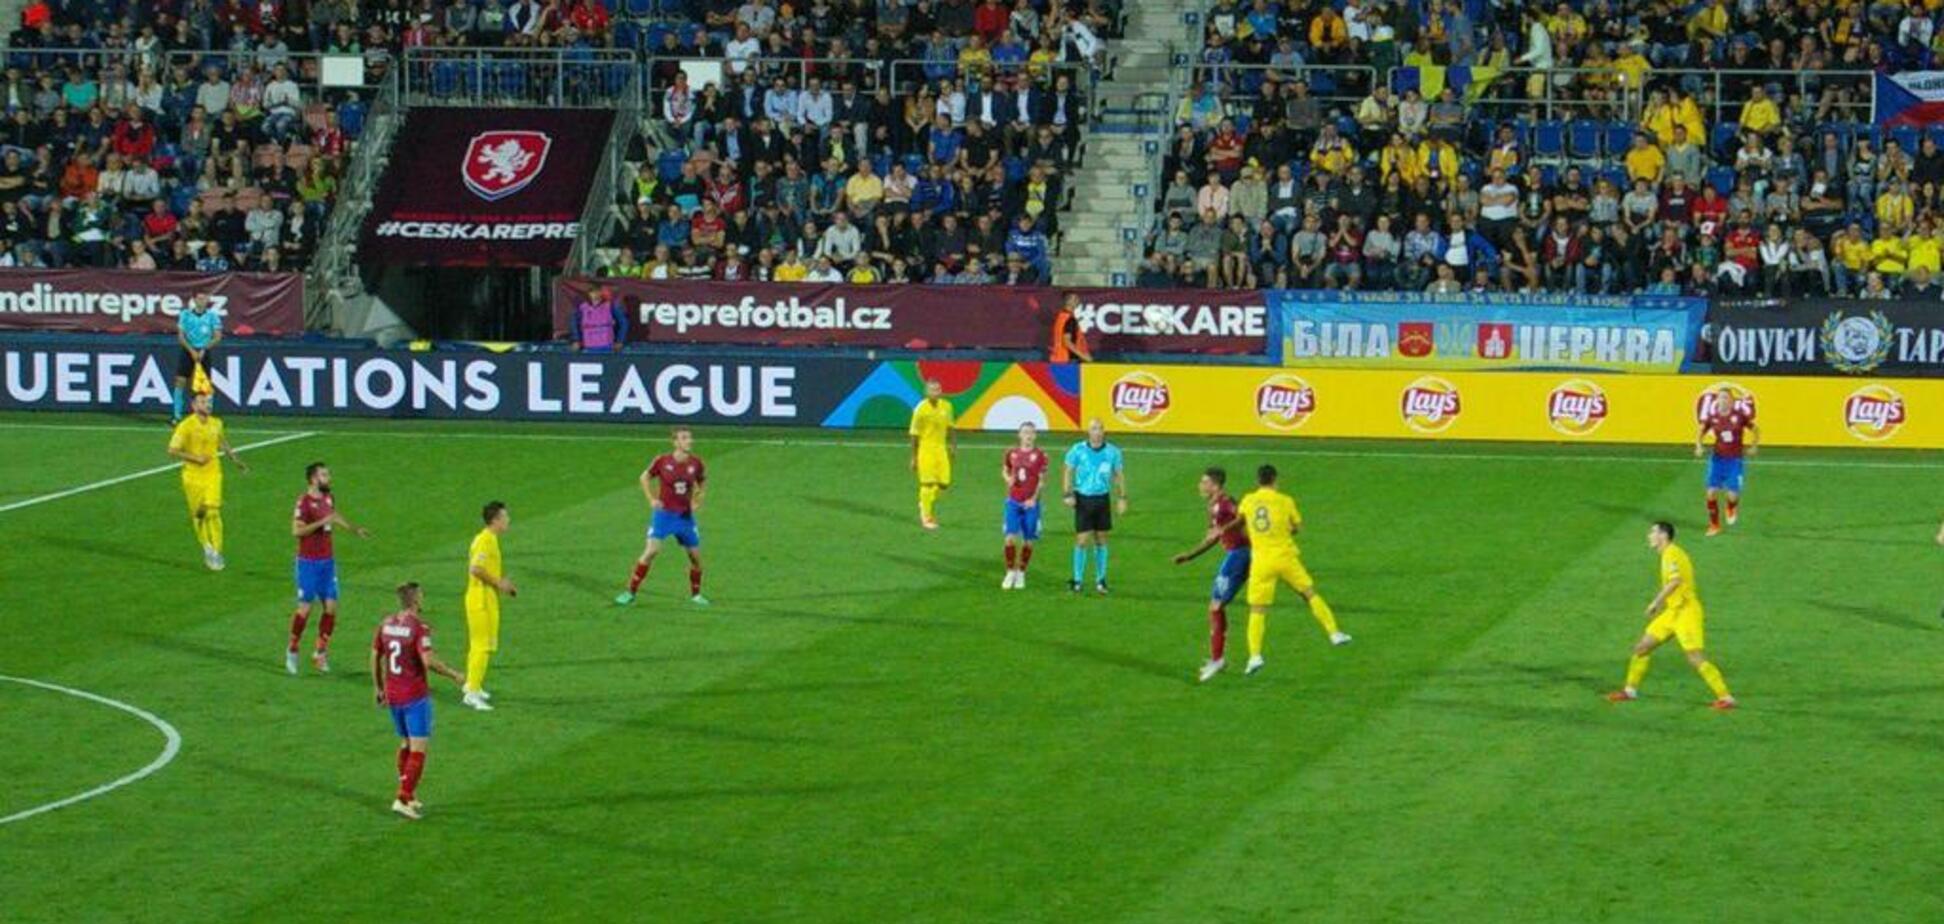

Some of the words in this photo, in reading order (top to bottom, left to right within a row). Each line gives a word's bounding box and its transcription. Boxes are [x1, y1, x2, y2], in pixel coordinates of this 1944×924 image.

[376, 221, 580, 240] #CESKAREPRE
[639, 296, 892, 333] reprefotbal.cz
[1294, 320, 1390, 358] БІЛА
[1520, 325, 1674, 364] ЦЕРКВА
[1718, 325, 1815, 367] ОНУКИ
[5, 352, 174, 404] UEFA
[210, 355, 500, 412] NATIONS
[528, 362, 797, 417] LEAGUE
[1115, 383, 1168, 415] Lay's
[1260, 386, 1312, 419] Lay's
[1407, 388, 1457, 420] Lay's
[1552, 390, 1603, 424] Lay's
[1849, 398, 1900, 429] Lay's
[1254, 506, 1270, 533] 8
[388, 640, 402, 675] 2
